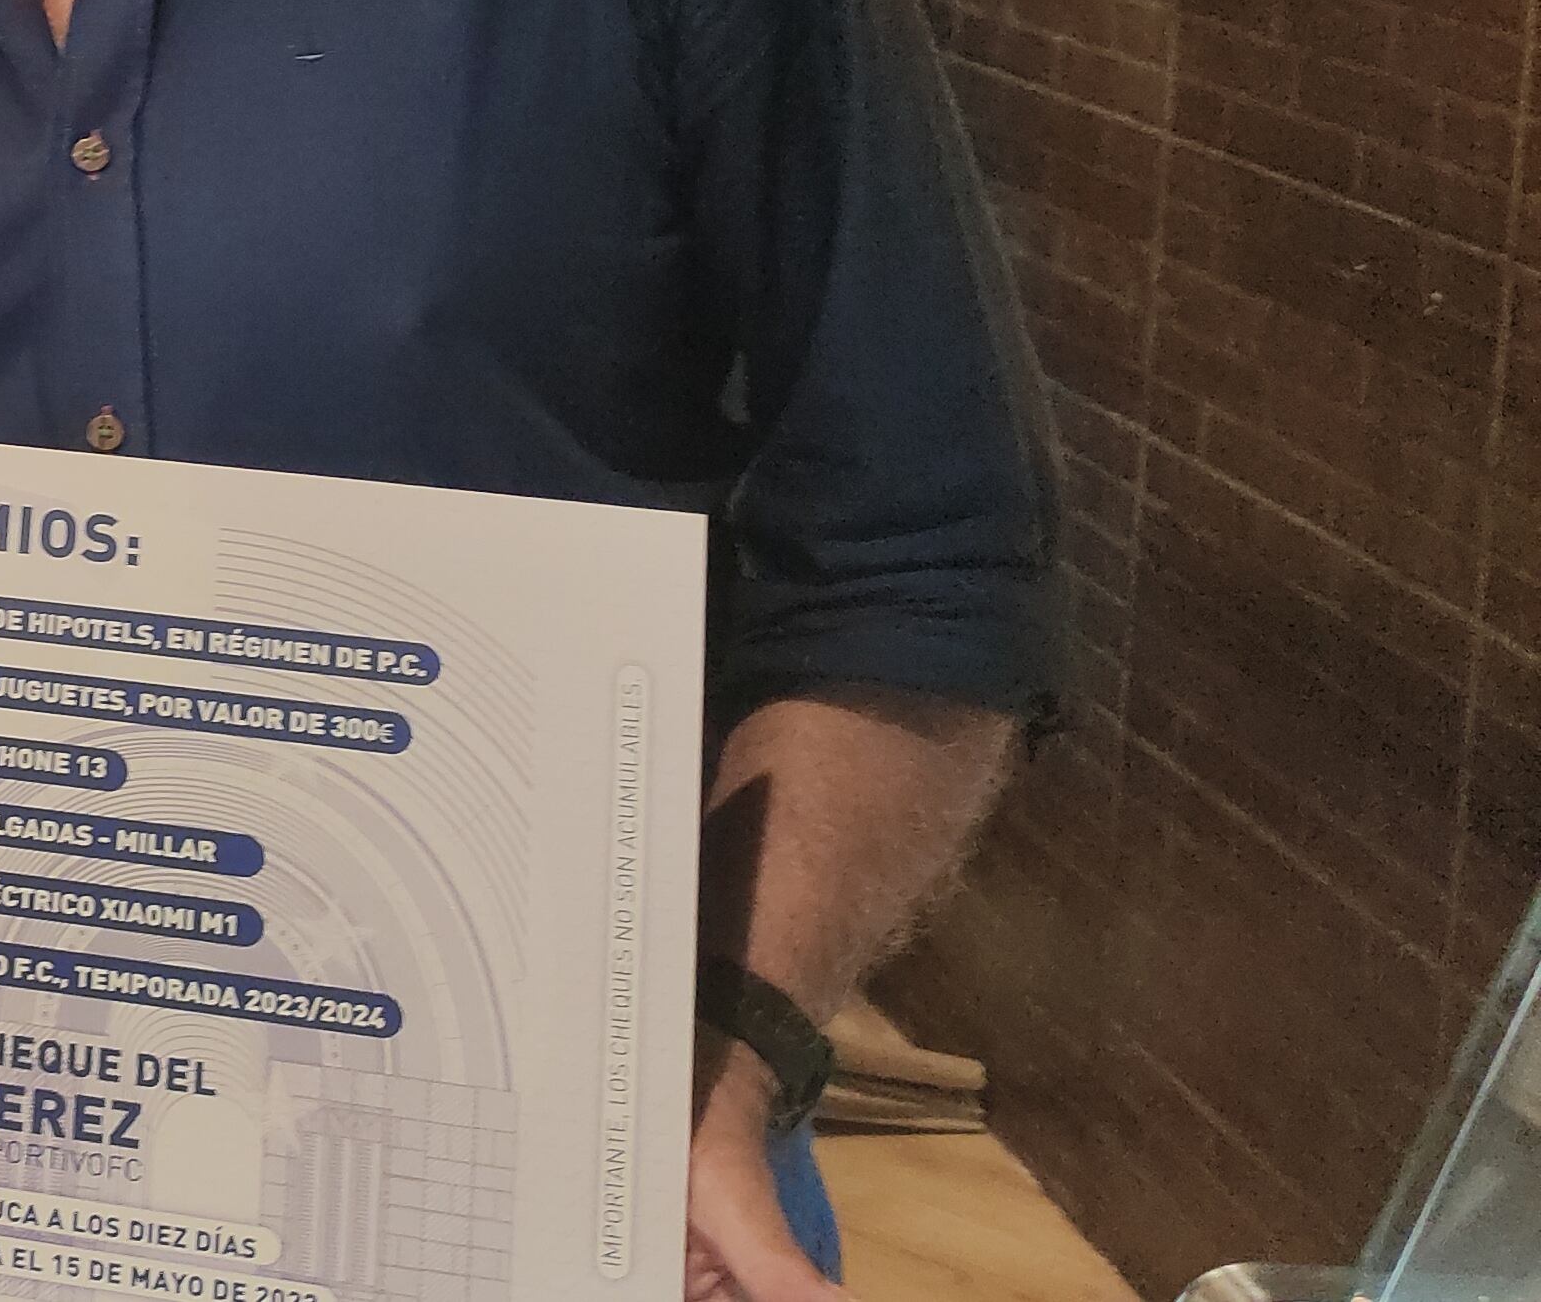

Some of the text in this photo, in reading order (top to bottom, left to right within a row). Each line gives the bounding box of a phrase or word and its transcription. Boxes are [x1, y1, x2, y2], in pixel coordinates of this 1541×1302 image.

[28, 612, 162, 651] HIPOTELS,
[166, 627, 205, 653] EN
[208, 628, 332, 667] RÉGIMEN
[336, 644, 372, 672] DE
[378, 651, 429, 679] P.C.
[138, 693, 194, 721] POR
[196, 699, 285, 730] VALOR
[289, 711, 325, 735] DE
[330, 715, 395, 744] 300€
[75, 754, 109, 779] 13
[114, 829, 220, 864] MILLAR
[616, 856, 636, 902] SON
[100, 899, 196, 932] XIAOMI
[199, 912, 239, 937] M1
[613, 909, 634, 941] NO
[73, 965, 240, 1011] TEMPORADA
[244, 989, 388, 1030] 2023/2024
[609, 949, 633, 1055] CHEQUES
[135, 1053, 217, 1095] DEL
[608, 1064, 630, 1105] LOS
[47, 1208, 64, 1229] A
[73, 1211, 120, 1238] LOS
[128, 1220, 188, 1248] DIEZ
[196, 1225, 258, 1259] DÍAS
[11, 1248, 43, 1273] EL
[52, 1254, 81, 1278] 15
[90, 1260, 122, 1284] DE
[130, 1267, 204, 1298] MAYO
[213, 1278, 247, 1302] DE
